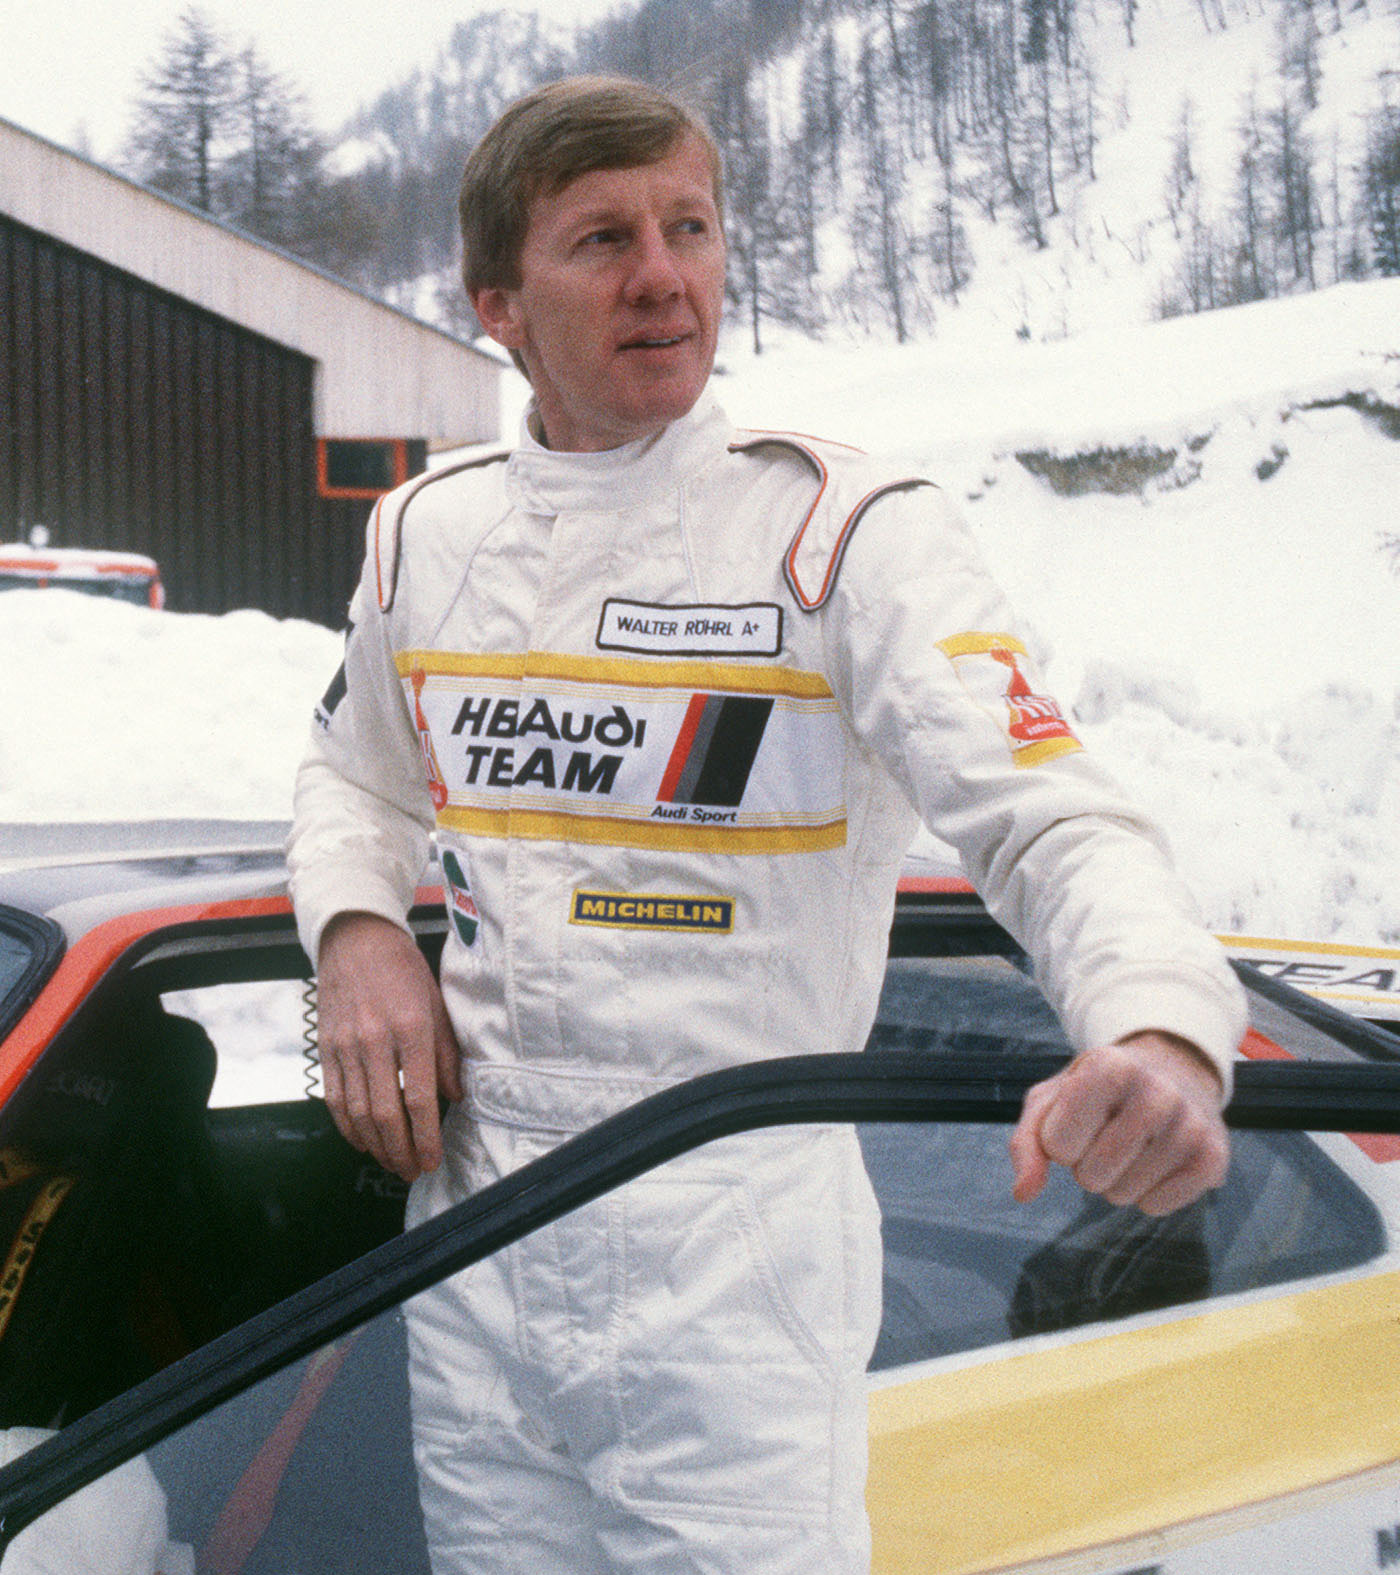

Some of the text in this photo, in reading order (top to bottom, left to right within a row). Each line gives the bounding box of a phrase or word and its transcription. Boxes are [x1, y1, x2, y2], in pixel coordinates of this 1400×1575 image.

[617, 616, 678, 637] WALTER
[684, 618, 734, 637] RÖHRL
[465, 746, 624, 794] TEAM
[650, 805, 738, 823] Audi Sport
[581, 900, 723, 922] MICHELIN
[1237, 958, 1400, 992] TEA
